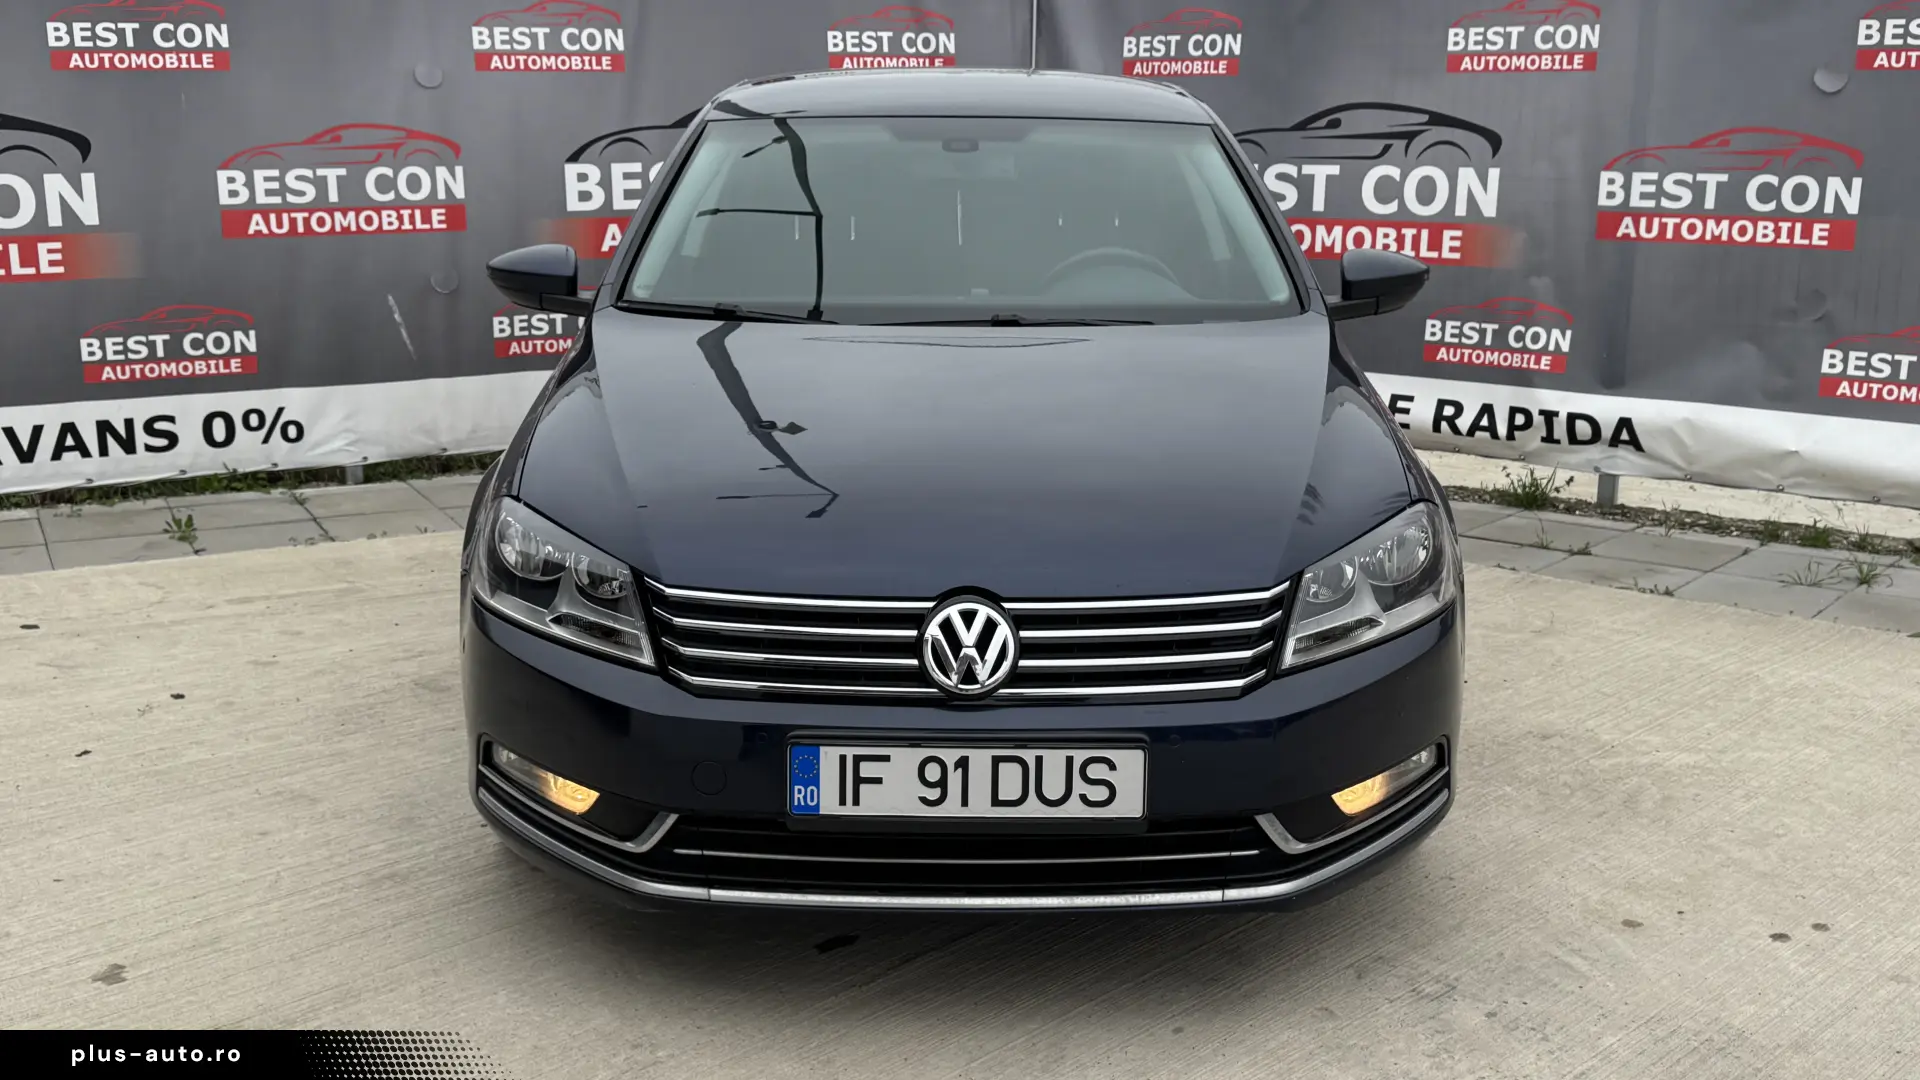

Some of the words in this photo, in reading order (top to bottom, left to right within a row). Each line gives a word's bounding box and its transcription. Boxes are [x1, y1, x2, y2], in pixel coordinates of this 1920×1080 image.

[46, 22, 139, 48] BEST
[152, 22, 230, 48] CON
[472, 26, 550, 51] BEST
[560, 28, 625, 51] CON
[827, 31, 893, 53] BEST
[901, 32, 956, 54] CON
[1123, 35, 1181, 58] BEST
[1187, 33, 1242, 56] CON
[1447, 26, 1525, 52] BEST
[1534, 23, 1600, 49] CON
[69, 53, 215, 69] AUTOMOBILE
[490, 55, 612, 70] AUTOMOBILE
[842, 57, 944, 69] AUTOMOBILE
[1132, 60, 1228, 75] AUTOMOBILE
[1460, 54, 1584, 71] AUTOMOBILE
[1873, 51, 1920, 68] AUT
[216, 167, 346, 205] BEST
[365, 165, 466, 202] CON
[564, 161, 664, 212] BE
[1254, 163, 1340, 212] ST
[1361, 165, 1500, 218] CON
[1597, 170, 1729, 210] BEST
[1745, 173, 1863, 215] CON
[0, 172, 100, 229] ON
[248, 208, 447, 235] AUTOMOBILE
[1616, 216, 1830, 246] AUTOMOBILE
[492, 313, 568, 338] BEST
[1424, 319, 1498, 346] BEST
[1508, 326, 1572, 352] CON
[80, 334, 171, 362] BEST
[182, 329, 257, 356] CON
[508, 339, 572, 355] AUTOM
[101, 359, 242, 381] AUTOMOBILE
[1436, 347, 1552, 370] AUTOMOBILE
[1821, 348, 1918, 380] BEST
[1836, 380, 1920, 403] AUTOM
[0, 414, 180, 466] VANS
[202, 406, 305, 449] 0%
[1432, 398, 1646, 453] RAPIDA
[838, 754, 891, 807] IF
[917, 755, 970, 807] 91
[990, 755, 1118, 808] DUS
[794, 785, 818, 806] RO
